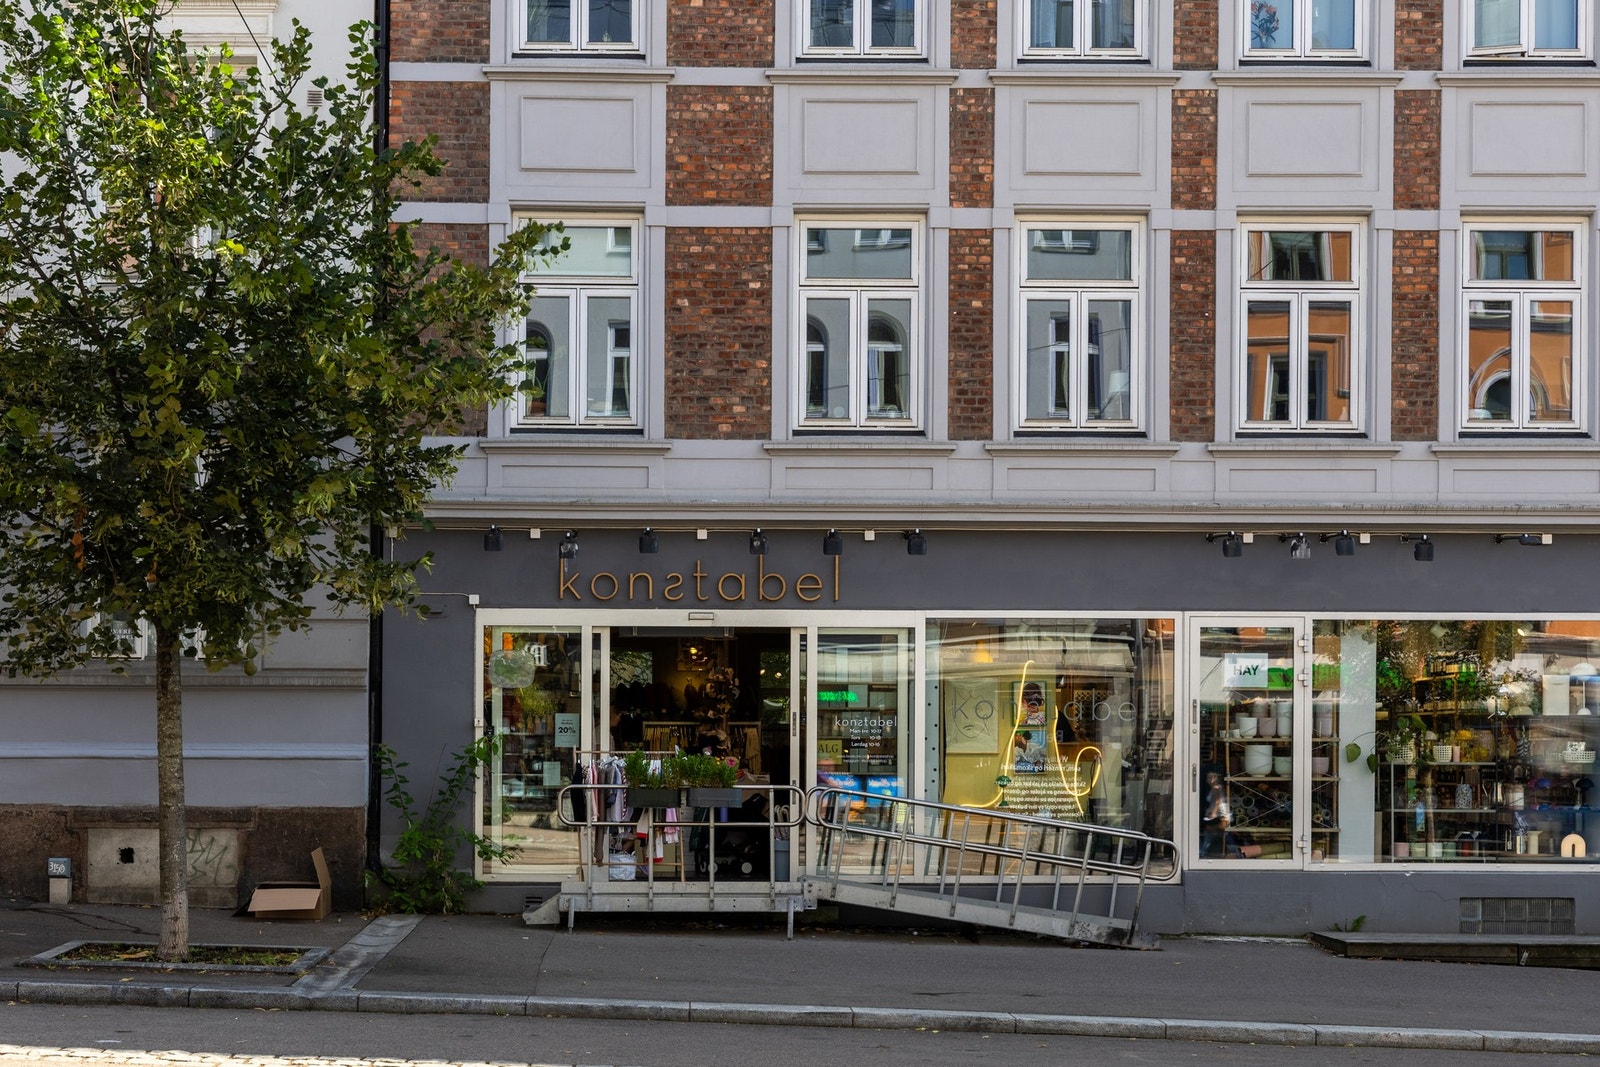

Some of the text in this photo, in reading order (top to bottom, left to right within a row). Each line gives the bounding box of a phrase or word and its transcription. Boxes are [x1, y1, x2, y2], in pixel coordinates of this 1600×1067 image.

[559, 554, 839, 601] konstabel
[1233, 664, 1259, 676] HAY
[834, 715, 897, 727] konstabel
[558, 726, 577, 735] 20%
